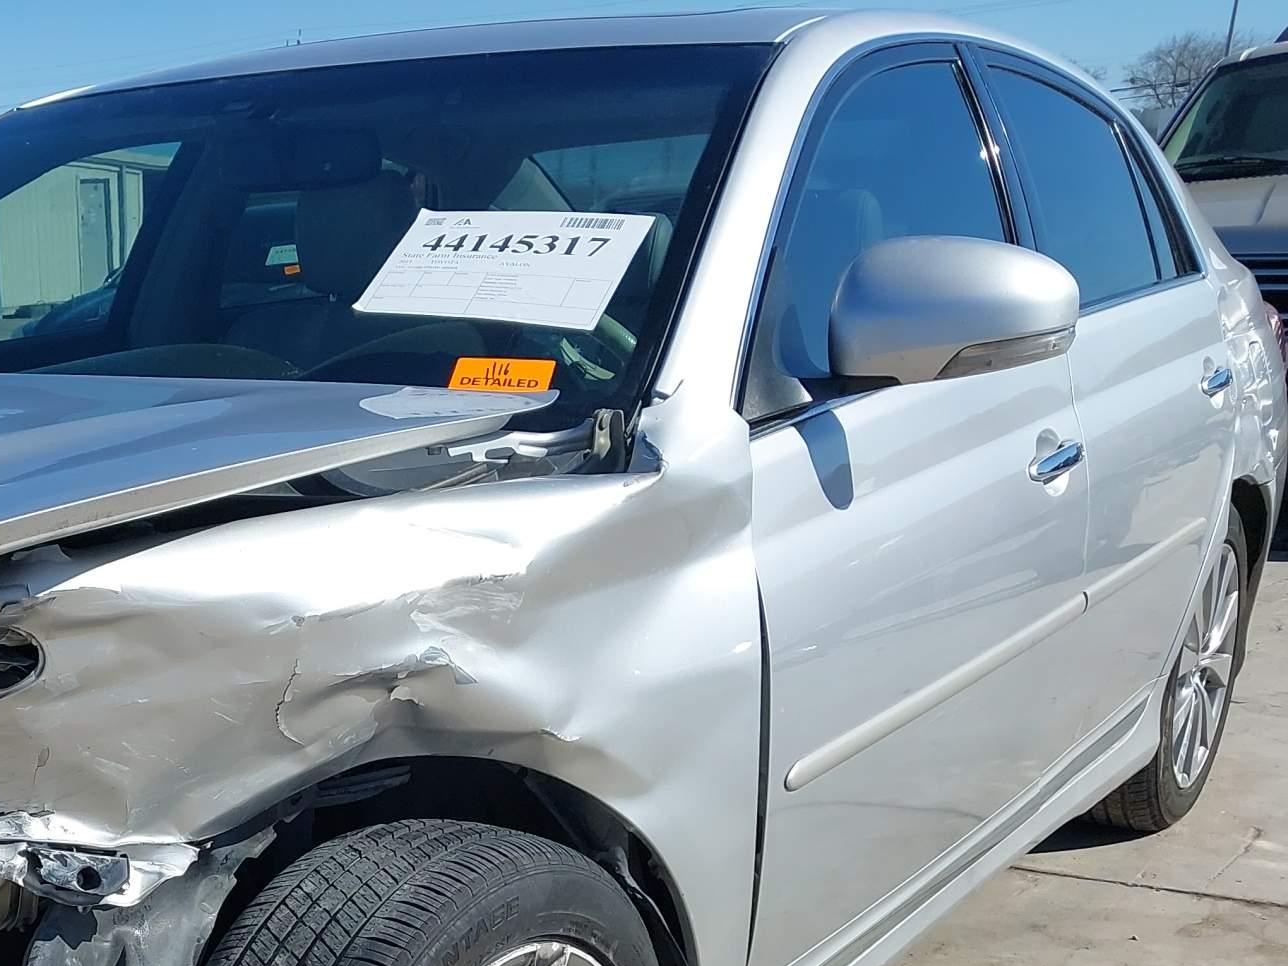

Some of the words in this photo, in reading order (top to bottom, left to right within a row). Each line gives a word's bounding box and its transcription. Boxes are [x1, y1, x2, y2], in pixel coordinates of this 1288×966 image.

[422, 233, 612, 257] 44145317
[401, 252, 425, 260] State
[426, 252, 450, 260] Farm
[452, 252, 498, 260] Insurance
[459, 376, 539, 389] DETAILED
